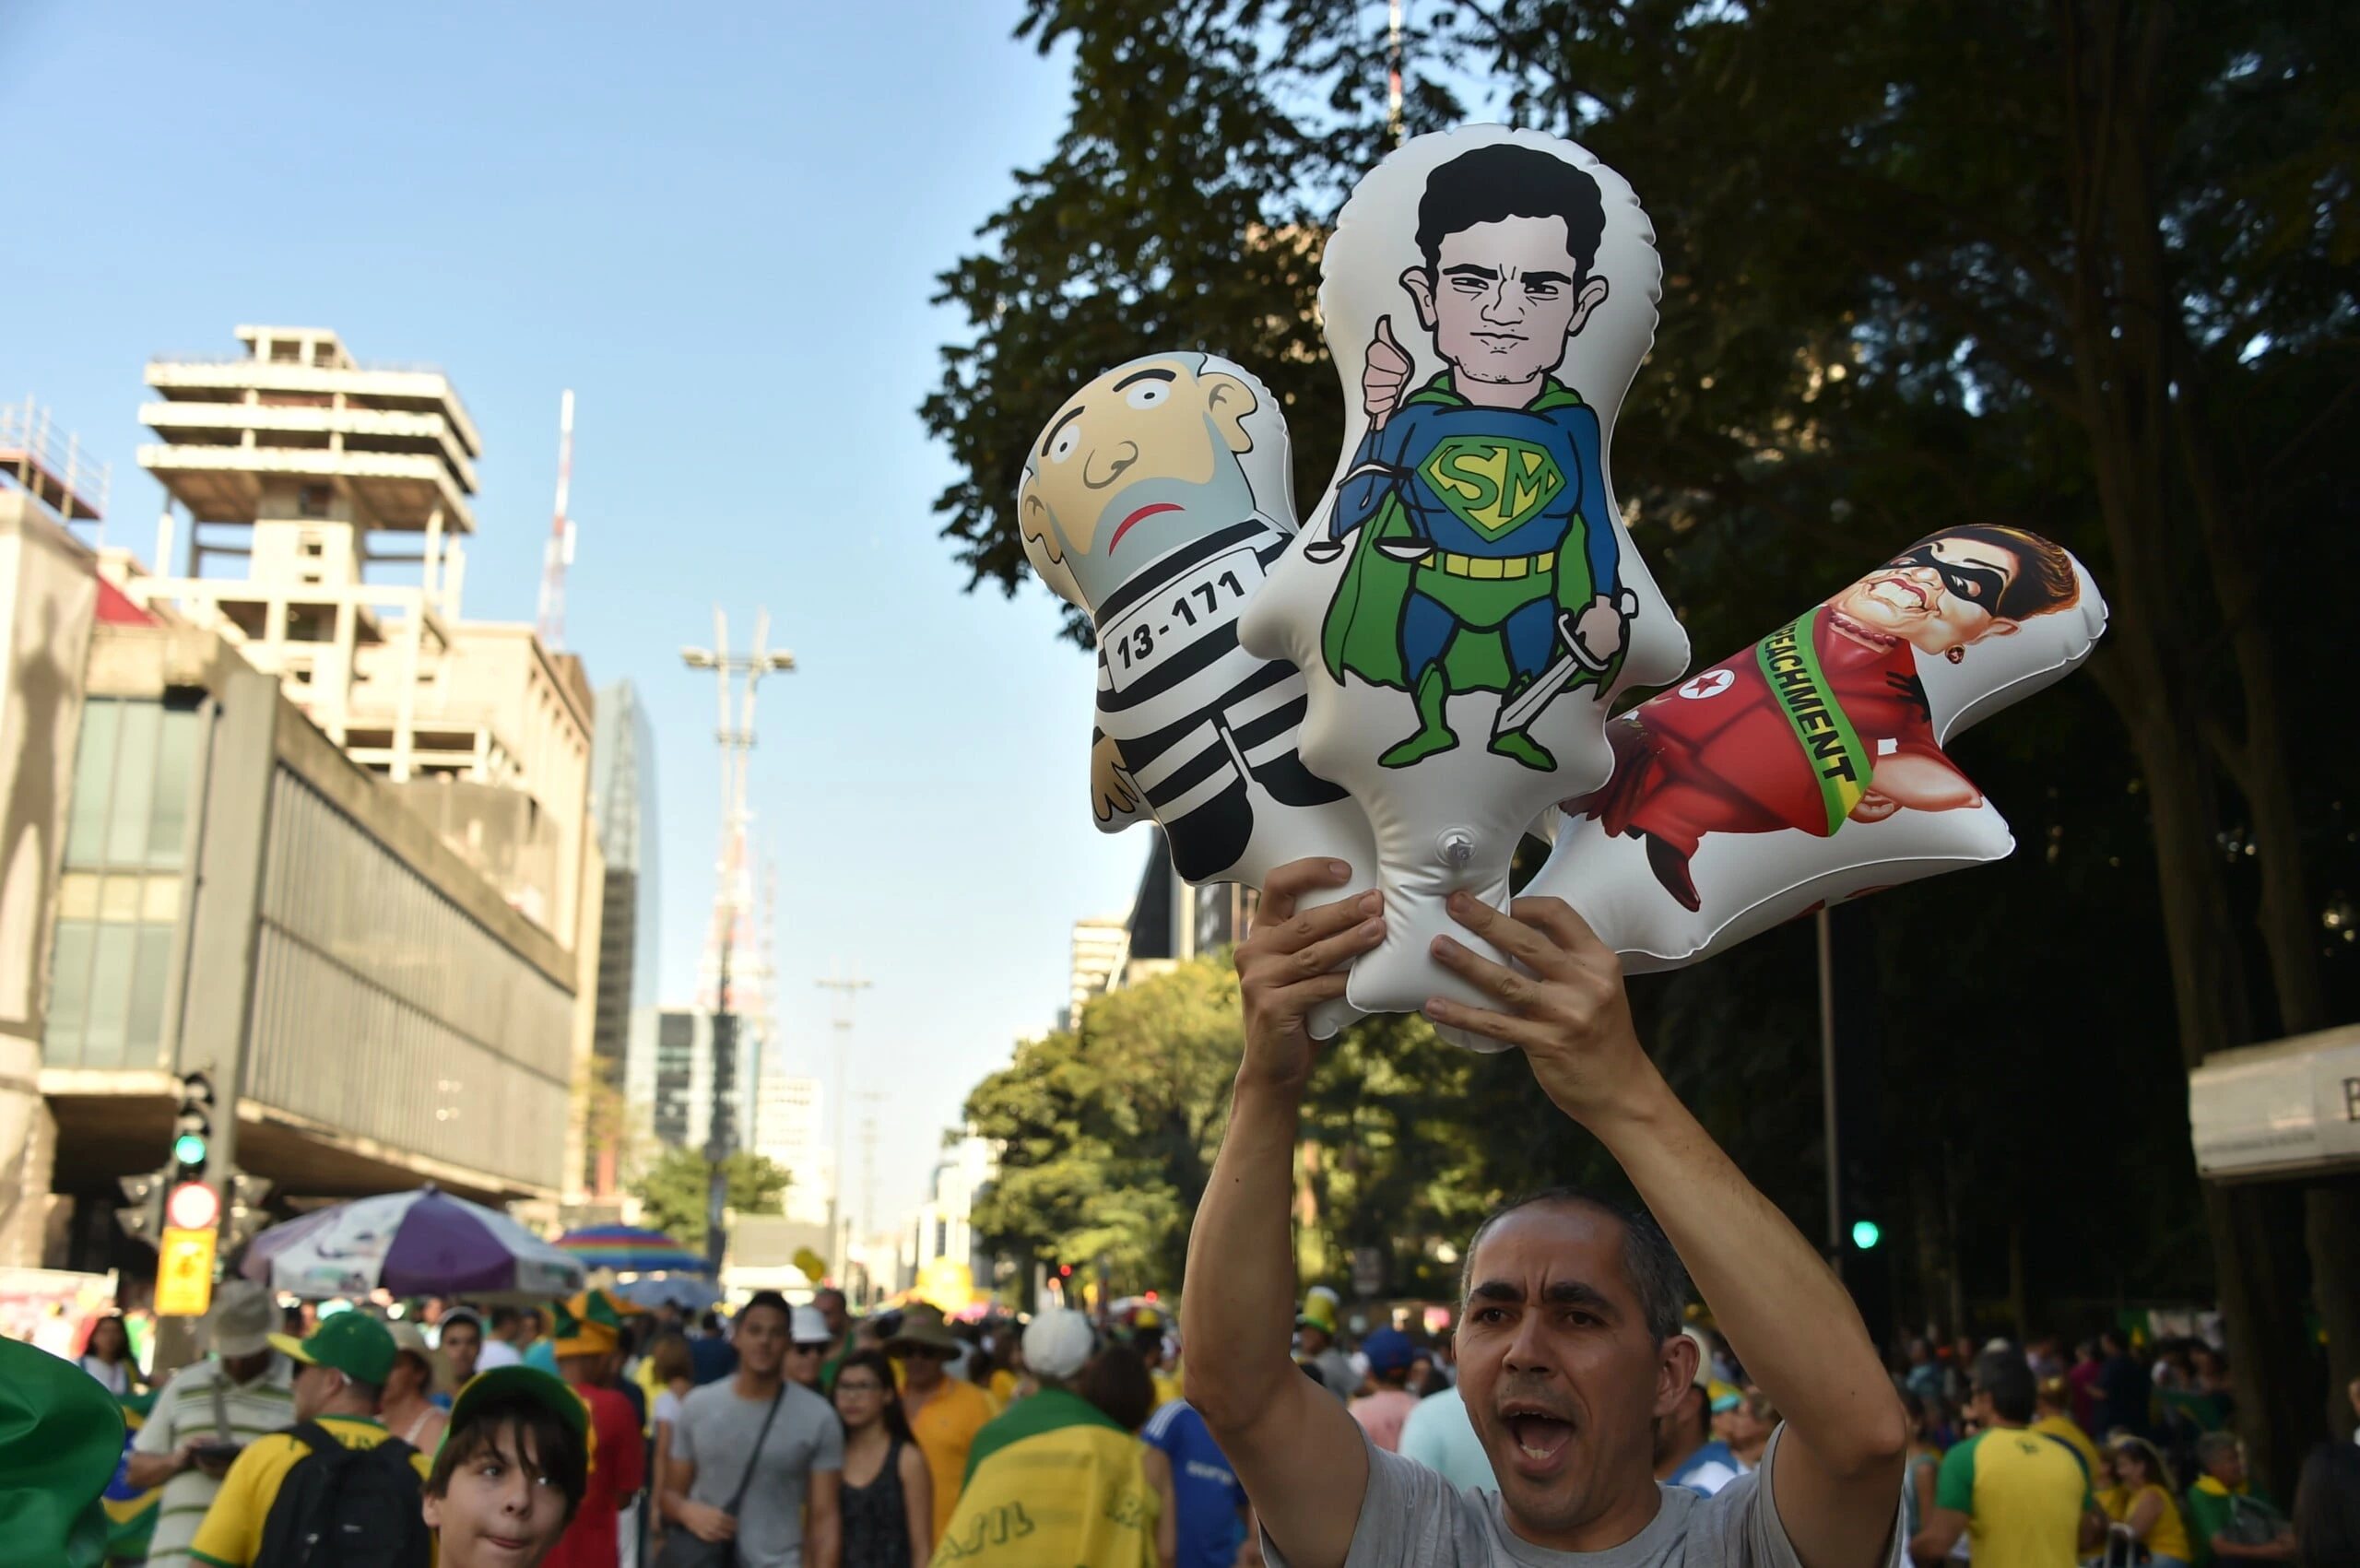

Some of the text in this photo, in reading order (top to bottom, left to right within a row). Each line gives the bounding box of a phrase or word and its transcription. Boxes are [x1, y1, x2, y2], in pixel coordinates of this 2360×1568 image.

[1438, 444, 1554, 518] SM
[1116, 570, 1245, 670] 13-171
[1764, 619, 1858, 783] PEACHMENT
